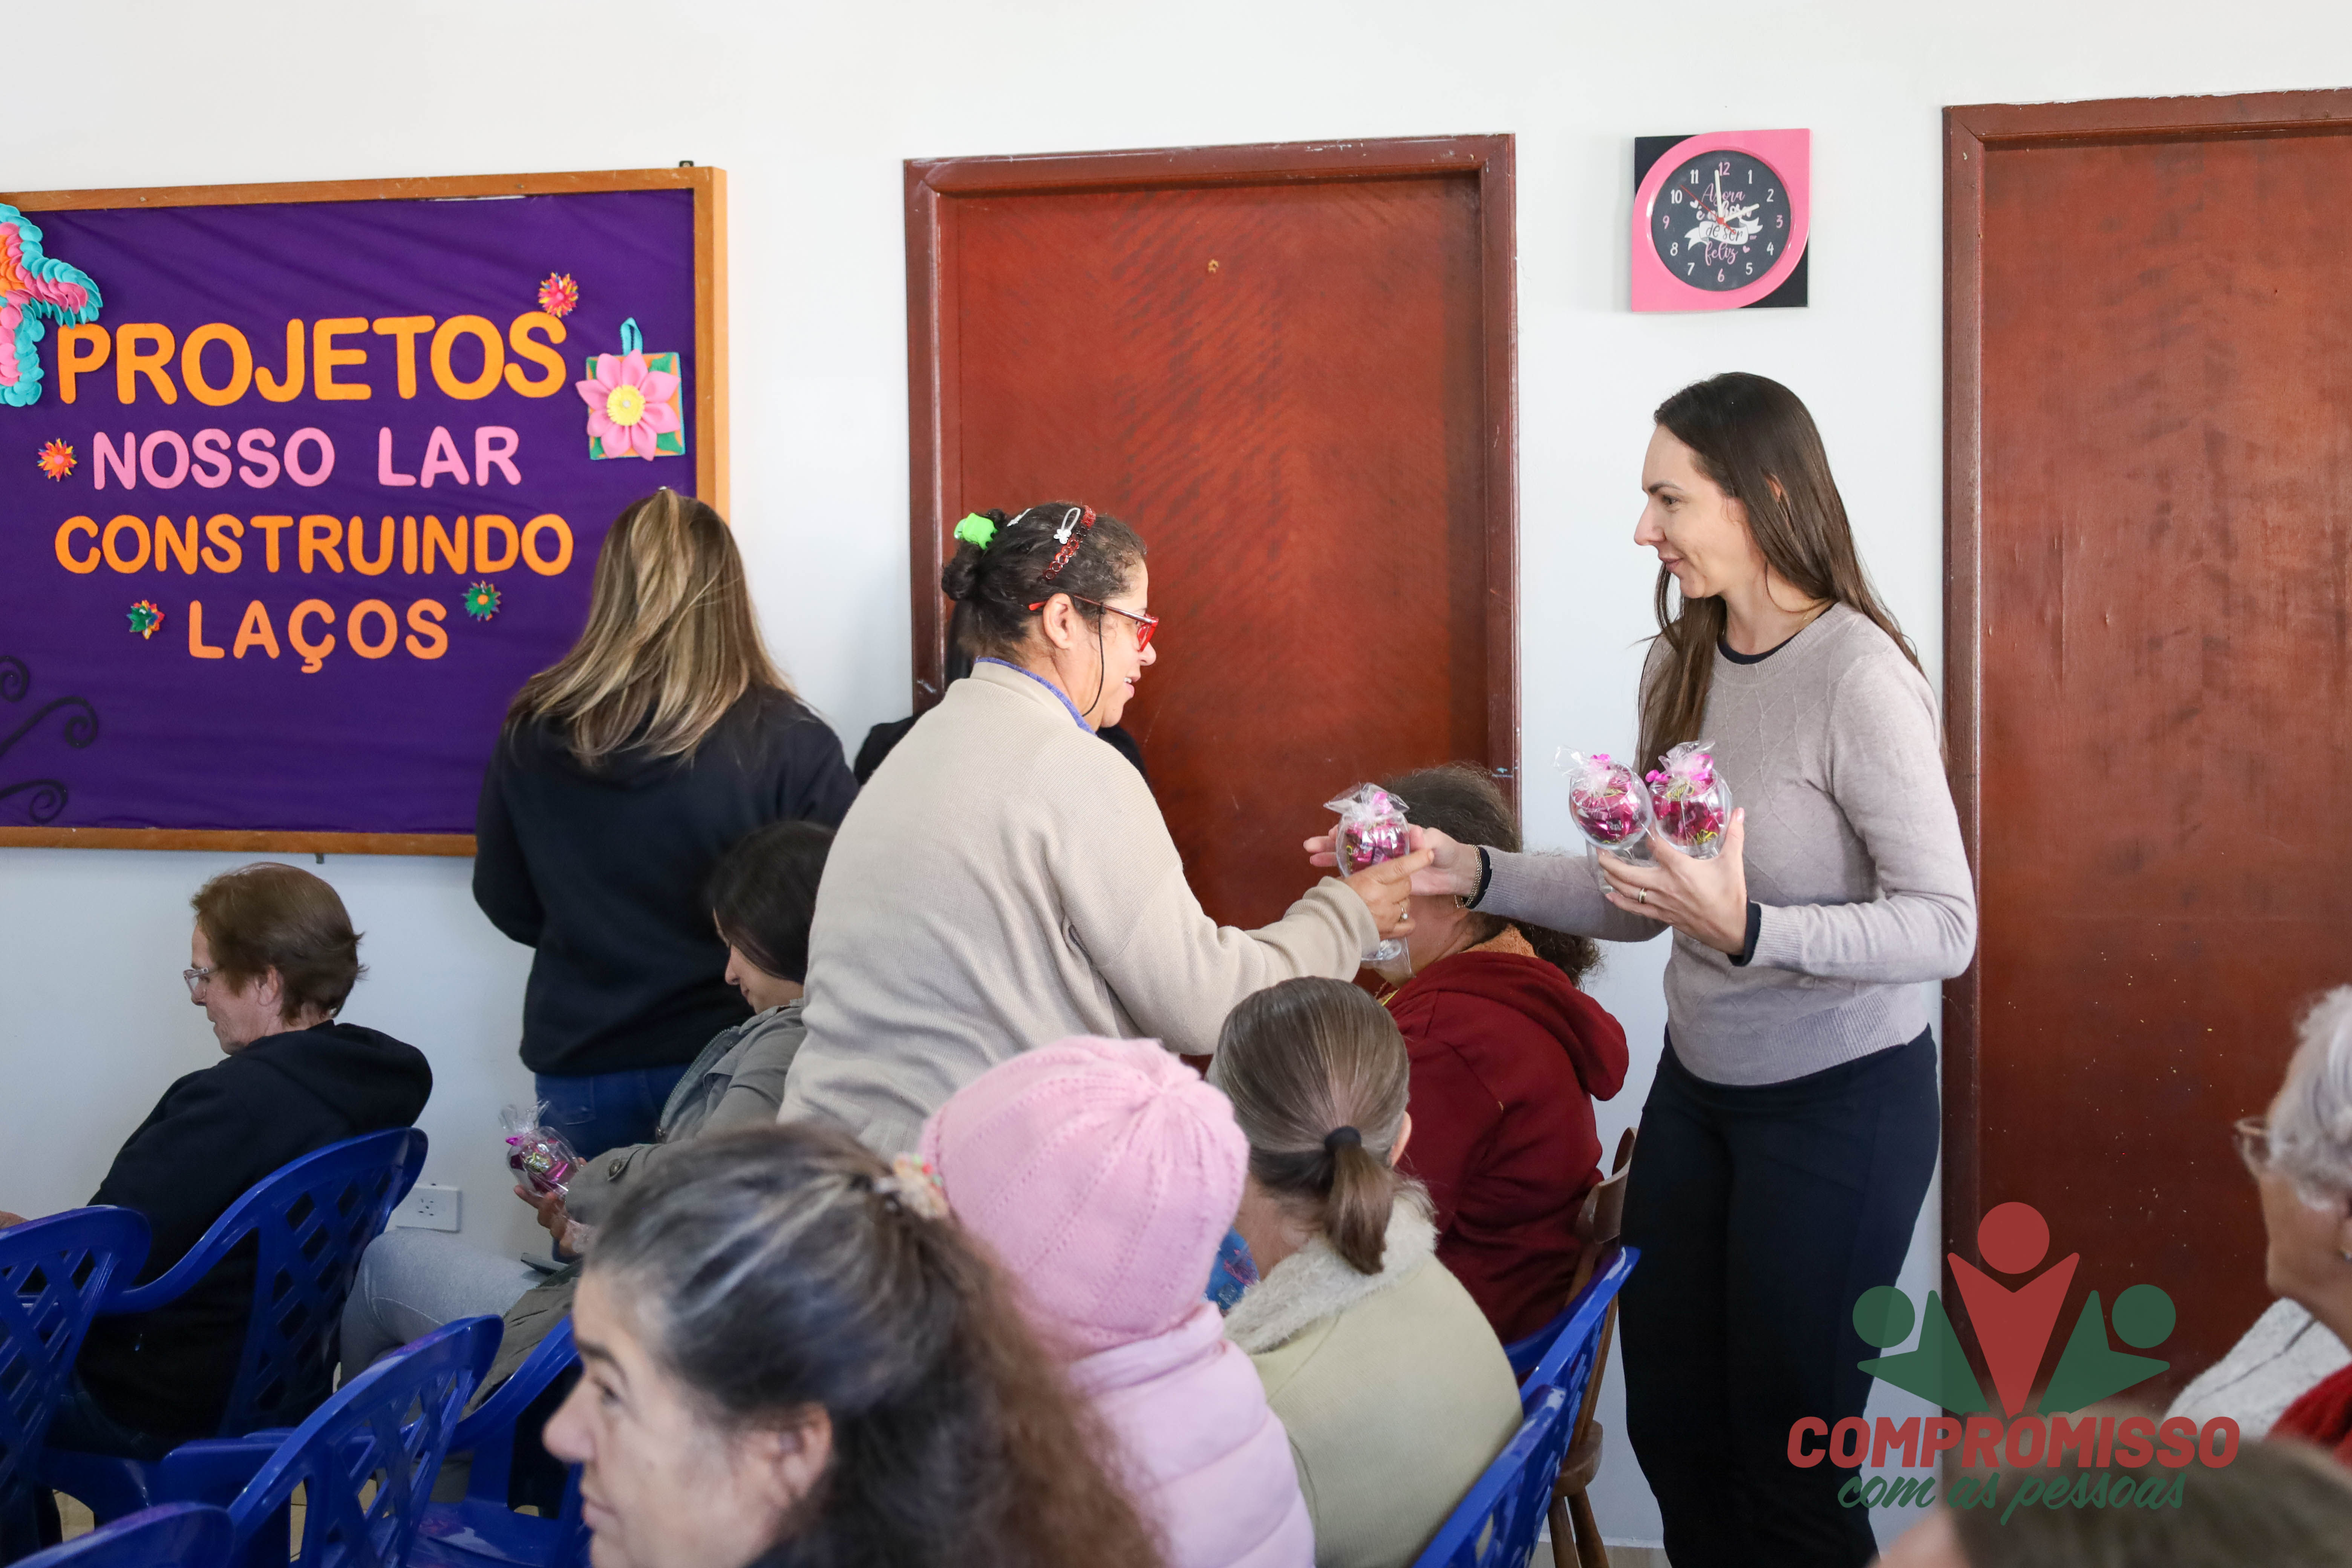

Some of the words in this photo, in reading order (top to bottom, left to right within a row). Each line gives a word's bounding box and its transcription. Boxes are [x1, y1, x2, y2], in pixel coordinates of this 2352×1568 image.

[1719, 162, 1730, 176] 12
[1690, 169, 1699, 184] 11
[1748, 169, 1752, 184] 1
[1671, 189, 1682, 204] 10
[1766, 189, 1774, 202] 2
[1663, 216, 1669, 229] 9
[1776, 215, 1783, 228] 3
[1706, 225, 1720, 237] de
[1723, 227, 1743, 242] ser
[1670, 242, 1678, 256] 8
[1705, 241, 1738, 266] feliz
[1767, 242, 1774, 256] 4
[1688, 263, 1695, 276] 7
[1718, 268, 1724, 282] 6
[1746, 263, 1752, 275] 5
[58, 312, 567, 406] PROJETOS
[93, 428, 335, 490] NOSSO
[378, 426, 521, 488] LAR
[55, 514, 573, 576] CONSTRUINDO
[189, 599, 447, 673] LAÇOS
